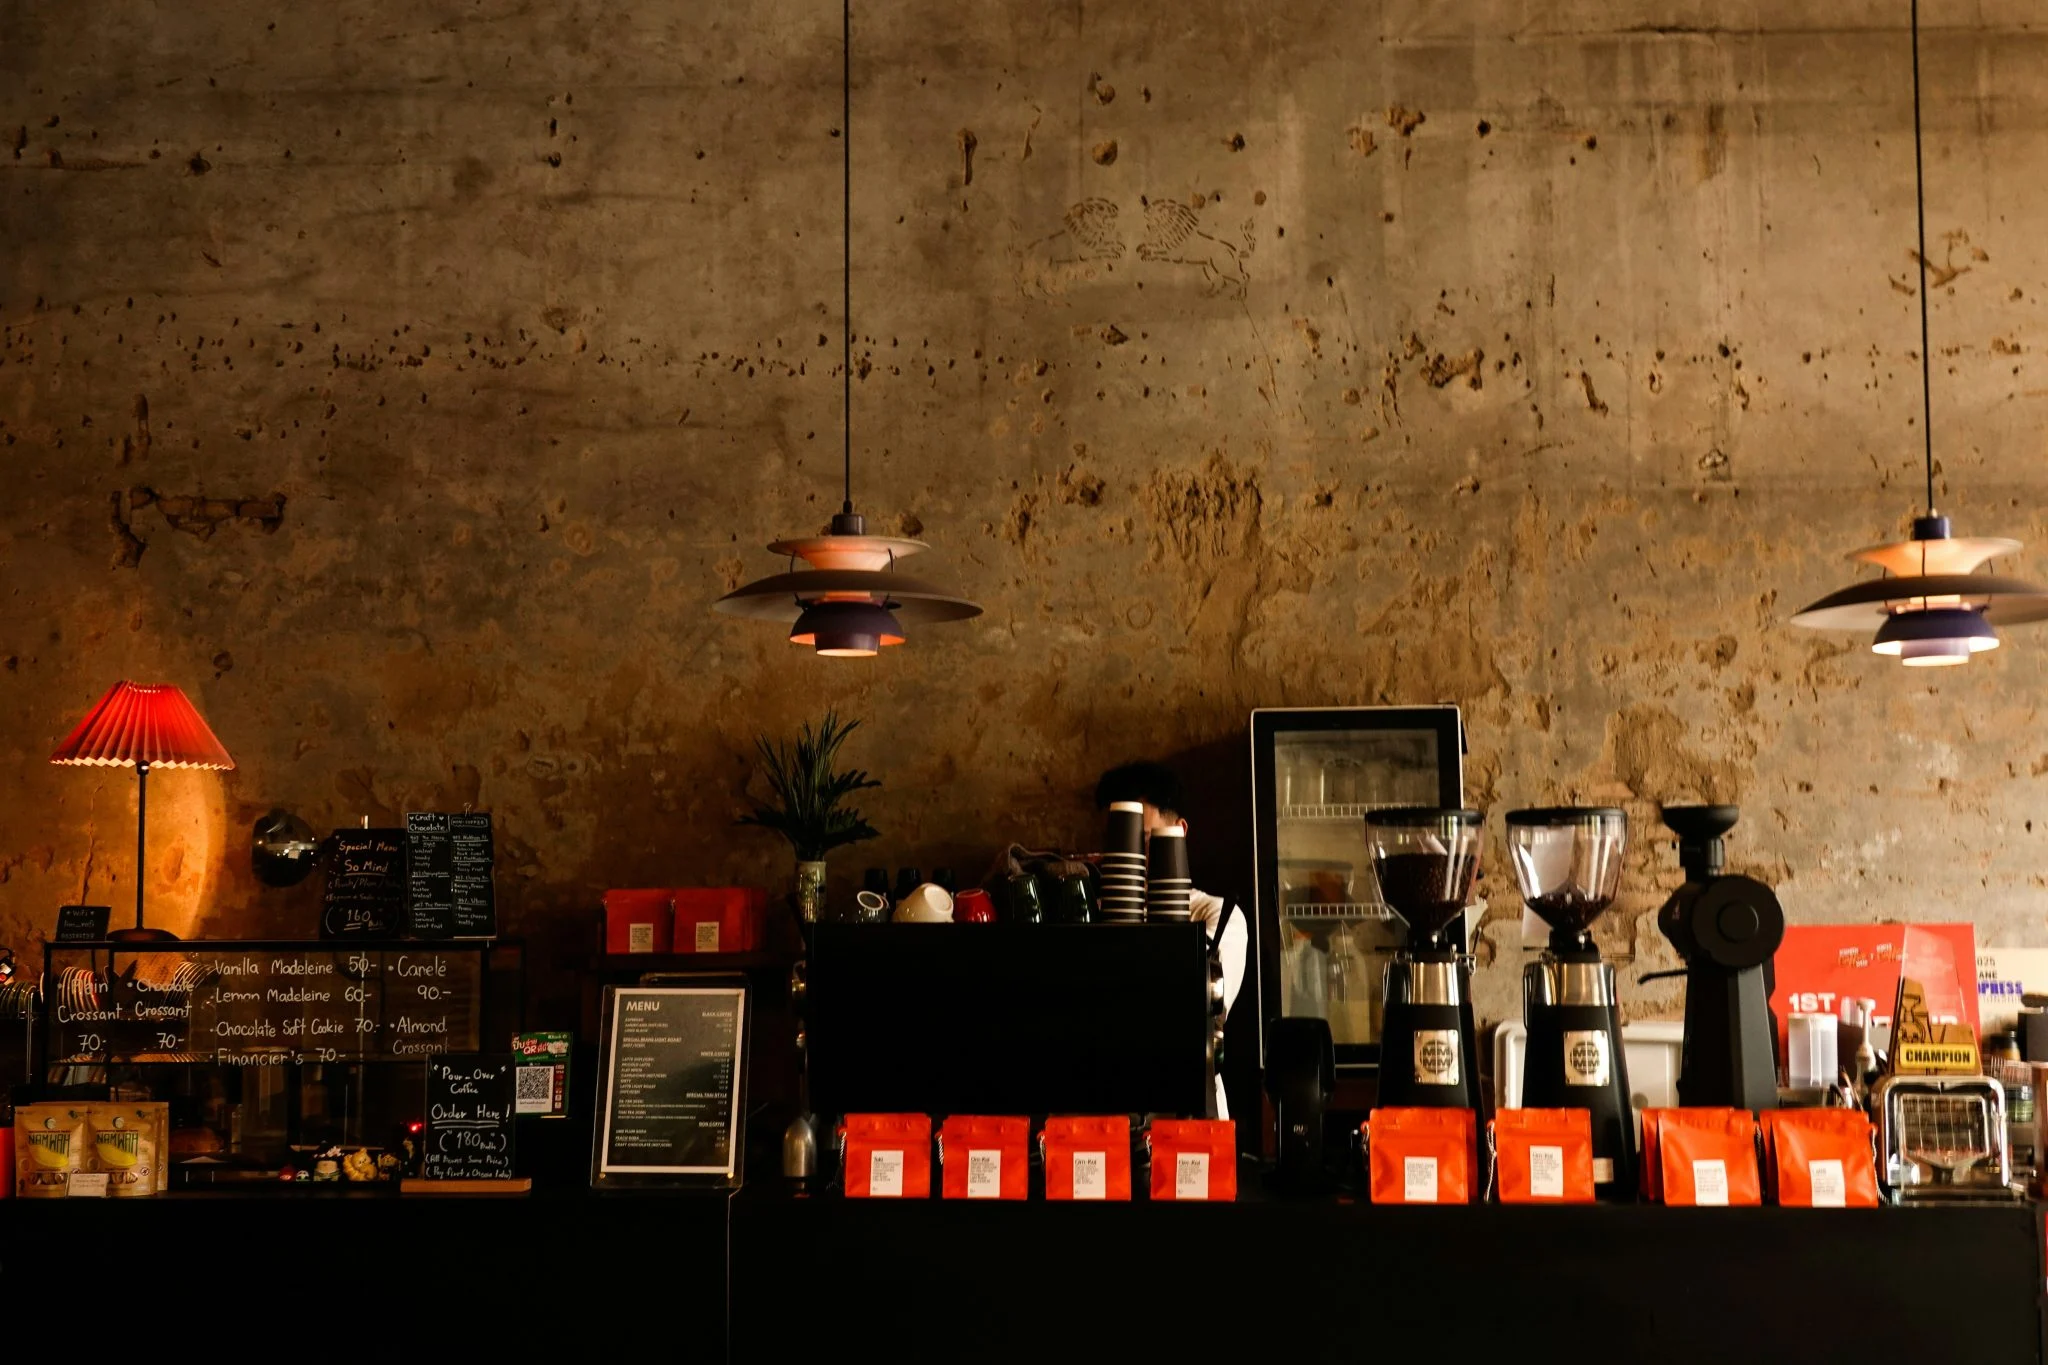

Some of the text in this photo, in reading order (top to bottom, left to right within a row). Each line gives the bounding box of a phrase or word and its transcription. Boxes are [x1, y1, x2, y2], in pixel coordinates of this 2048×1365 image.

[409, 824, 445, 832] Chocolate
[338, 839, 399, 855] Special Menu
[344, 859, 388, 872] So Mind
[347, 909, 371, 922] 160
[214, 956, 260, 977] Vanilla
[270, 956, 334, 975] Madeleine
[398, 955, 447, 977] Canelé
[215, 987, 260, 1003] Lemon
[266, 986, 331, 1002] Madeleine
[1978, 981, 2022, 994] PRESS
[135, 999, 193, 1019] Crossant
[626, 1001, 660, 1011] MENU
[1788, 992, 1836, 1013] 1ST
[57, 1002, 123, 1023] Crossant
[216, 1017, 277, 1037] Chocolate
[282, 1018, 306, 1036] Soft
[311, 1018, 344, 1036] Cookie
[392, 1037, 448, 1055] Crossant
[523, 1045, 537, 1054] QR
[217, 1047, 304, 1067] Financier's
[1905, 1048, 1970, 1063] CHAMPION
[450, 1082, 479, 1094] Coffee
[431, 1103, 467, 1120] Order
[477, 1103, 500, 1119] Here
[28, 1133, 71, 1158] NAMWAH
[96, 1132, 139, 1157] NAMWAH
[457, 1131, 480, 1149] 180
